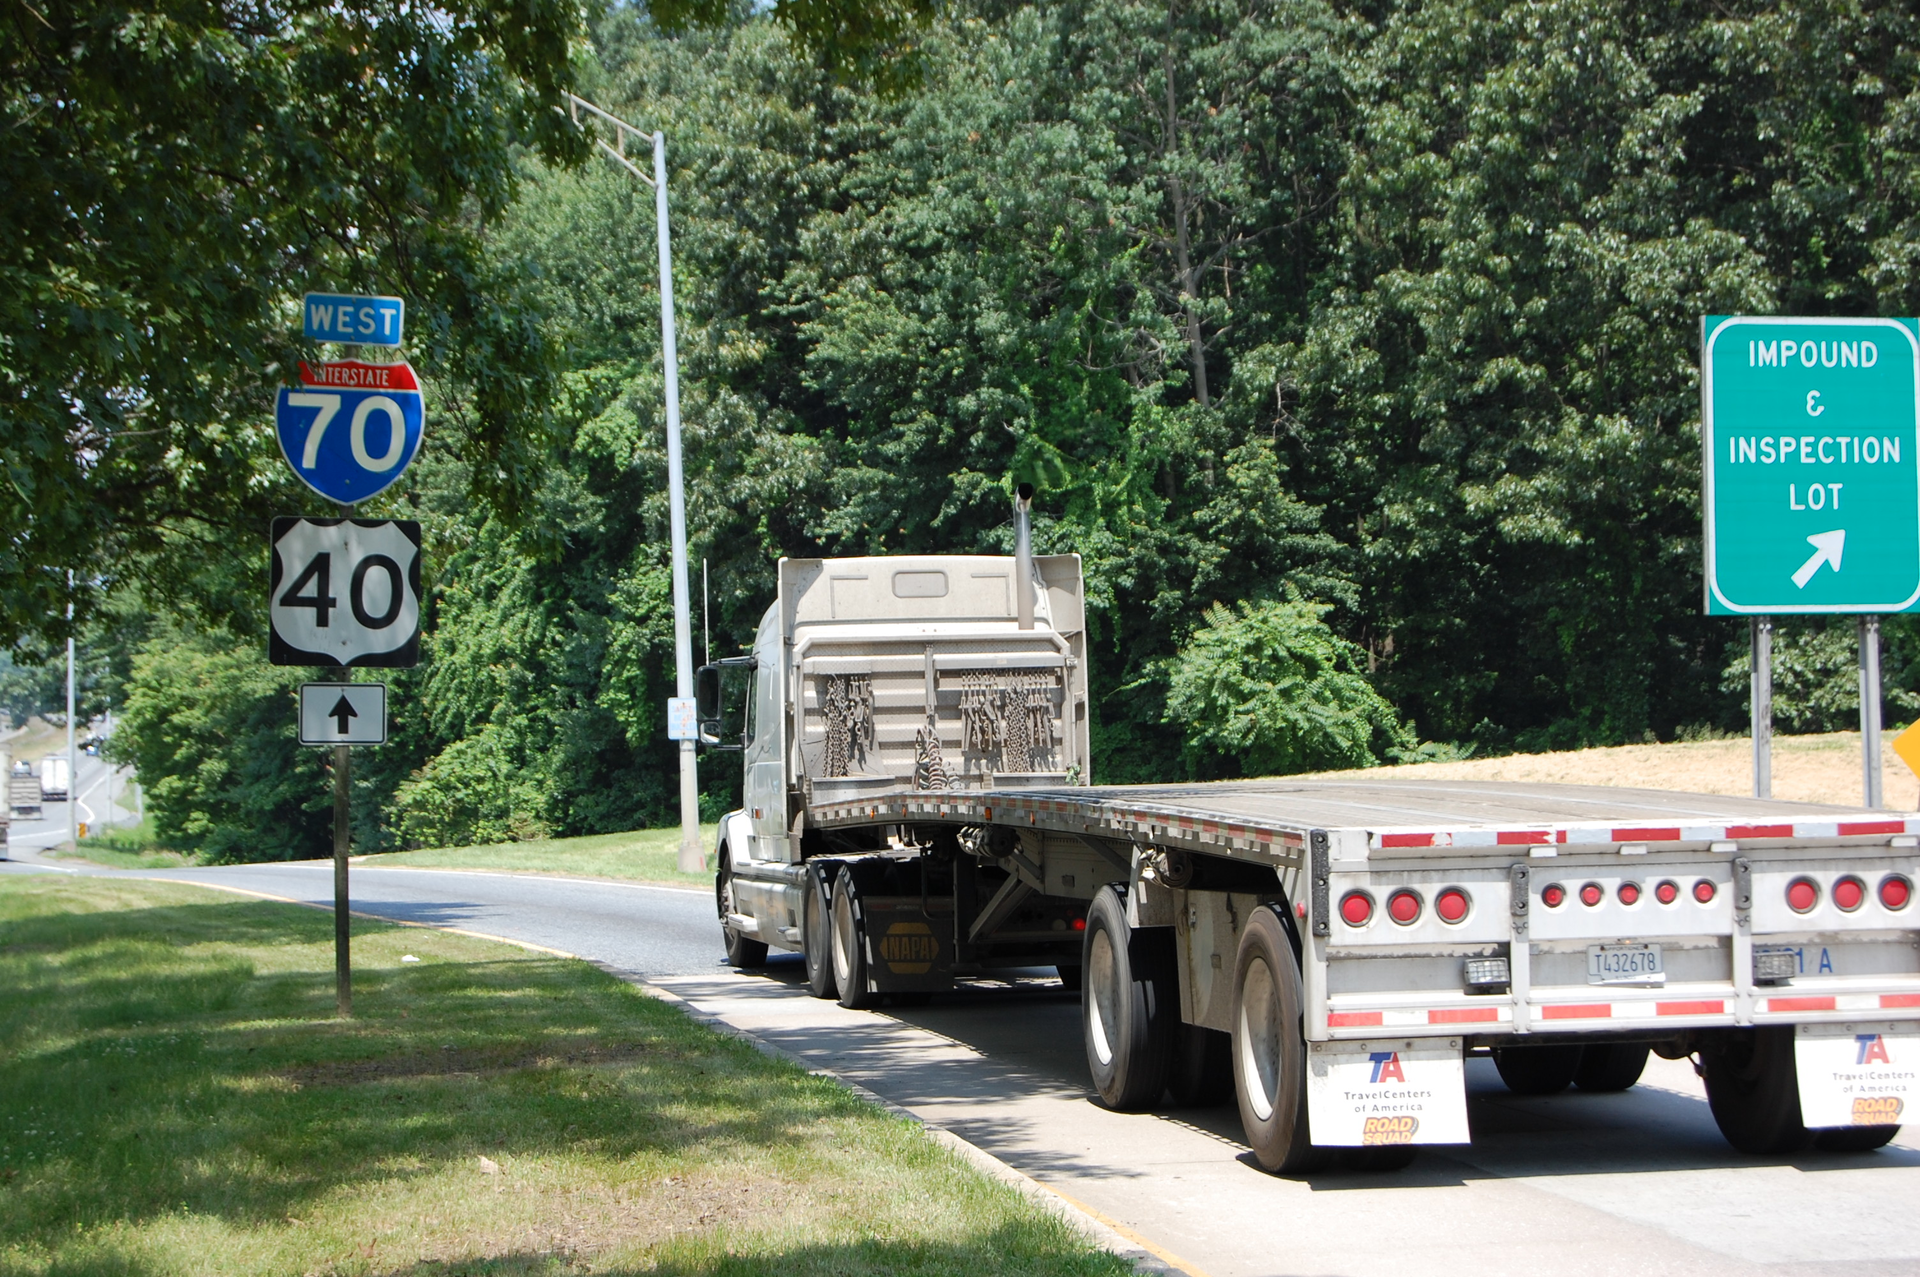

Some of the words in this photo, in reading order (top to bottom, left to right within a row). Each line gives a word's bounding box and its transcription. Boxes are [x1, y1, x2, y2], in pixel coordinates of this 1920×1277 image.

[310, 304, 397, 336] WEST
[1749, 340, 1878, 368] IMPOUND
[1806, 389, 1825, 416] &
[287, 393, 406, 473] 70
[1729, 436, 1900, 464] INSPECTION
[1789, 483, 1843, 510] LOT
[279, 551, 403, 630] 40
[888, 937, 931, 960] NAPA
[1594, 952, 1656, 973] T432678
[1854, 1033, 1890, 1065] TA
[1368, 1052, 1406, 1083] TA
[1832, 1071, 1915, 1081] TravelCenters
[1344, 1090, 1432, 1100] TravelCenters
[1843, 1084, 1854, 1093] of
[1859, 1084, 1907, 1093] America
[1354, 1104, 1366, 1113] of
[1371, 1103, 1423, 1112] America
[1852, 1096, 1900, 1113] ROAD
[1363, 1116, 1414, 1133] ROAD
[1362, 1131, 1413, 1145] SQUAD
